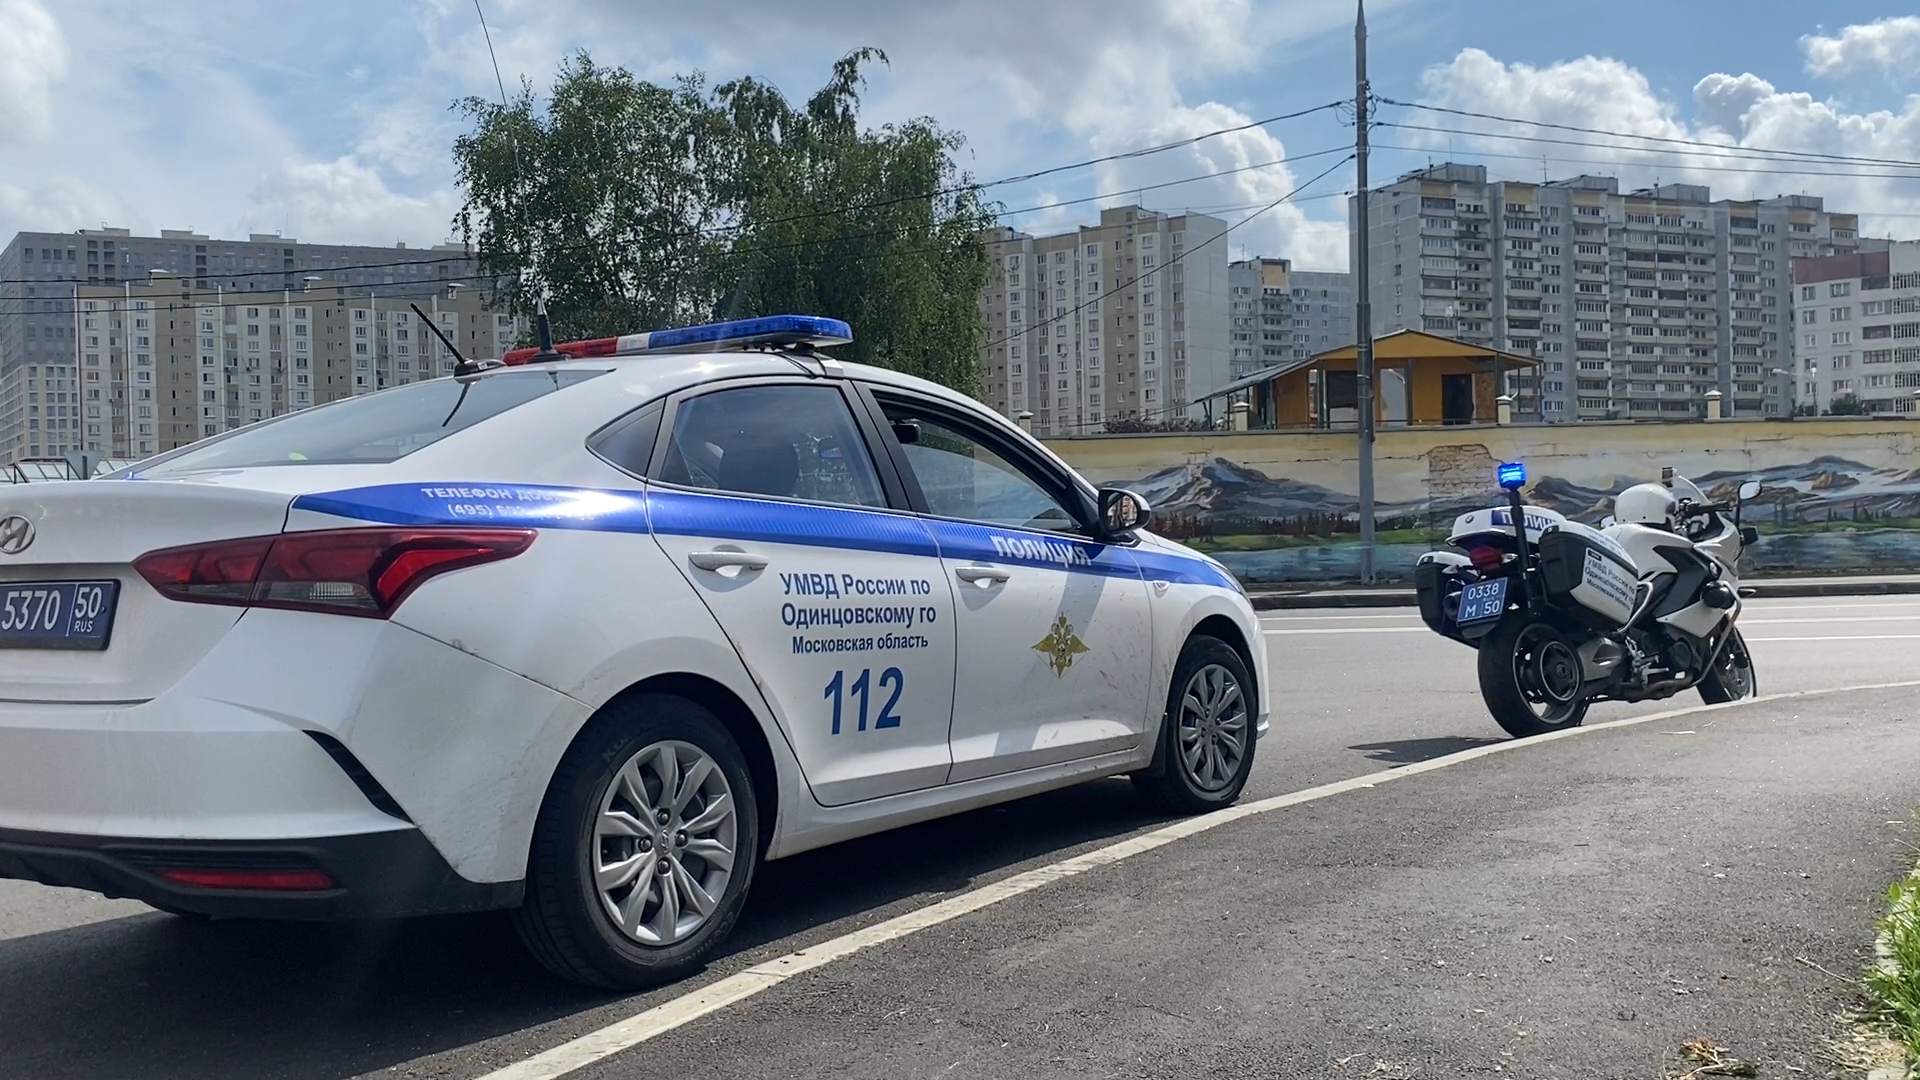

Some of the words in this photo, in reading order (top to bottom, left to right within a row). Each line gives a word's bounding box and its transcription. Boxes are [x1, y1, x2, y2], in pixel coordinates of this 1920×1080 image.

[421, 488, 512, 500] ТЕЛЕФОН
[447, 503, 493, 518] (495)
[989, 535, 1092, 568] ПОЛИЦИЯ
[779, 573, 840, 599] УМВД
[842, 574, 907, 595] России
[911, 579, 931, 595] по
[1468, 583, 1500, 600] 0338
[1, 590, 61, 630] 5370
[75, 586, 102, 618] 50
[781, 602, 915, 629] Одинцовскому
[919, 606, 937, 623] го
[1483, 600, 1500, 615] 50
[74, 620, 93, 633] RUS
[792, 636, 874, 654] Московская
[877, 632, 929, 649] область
[824, 666, 904, 736] 112
